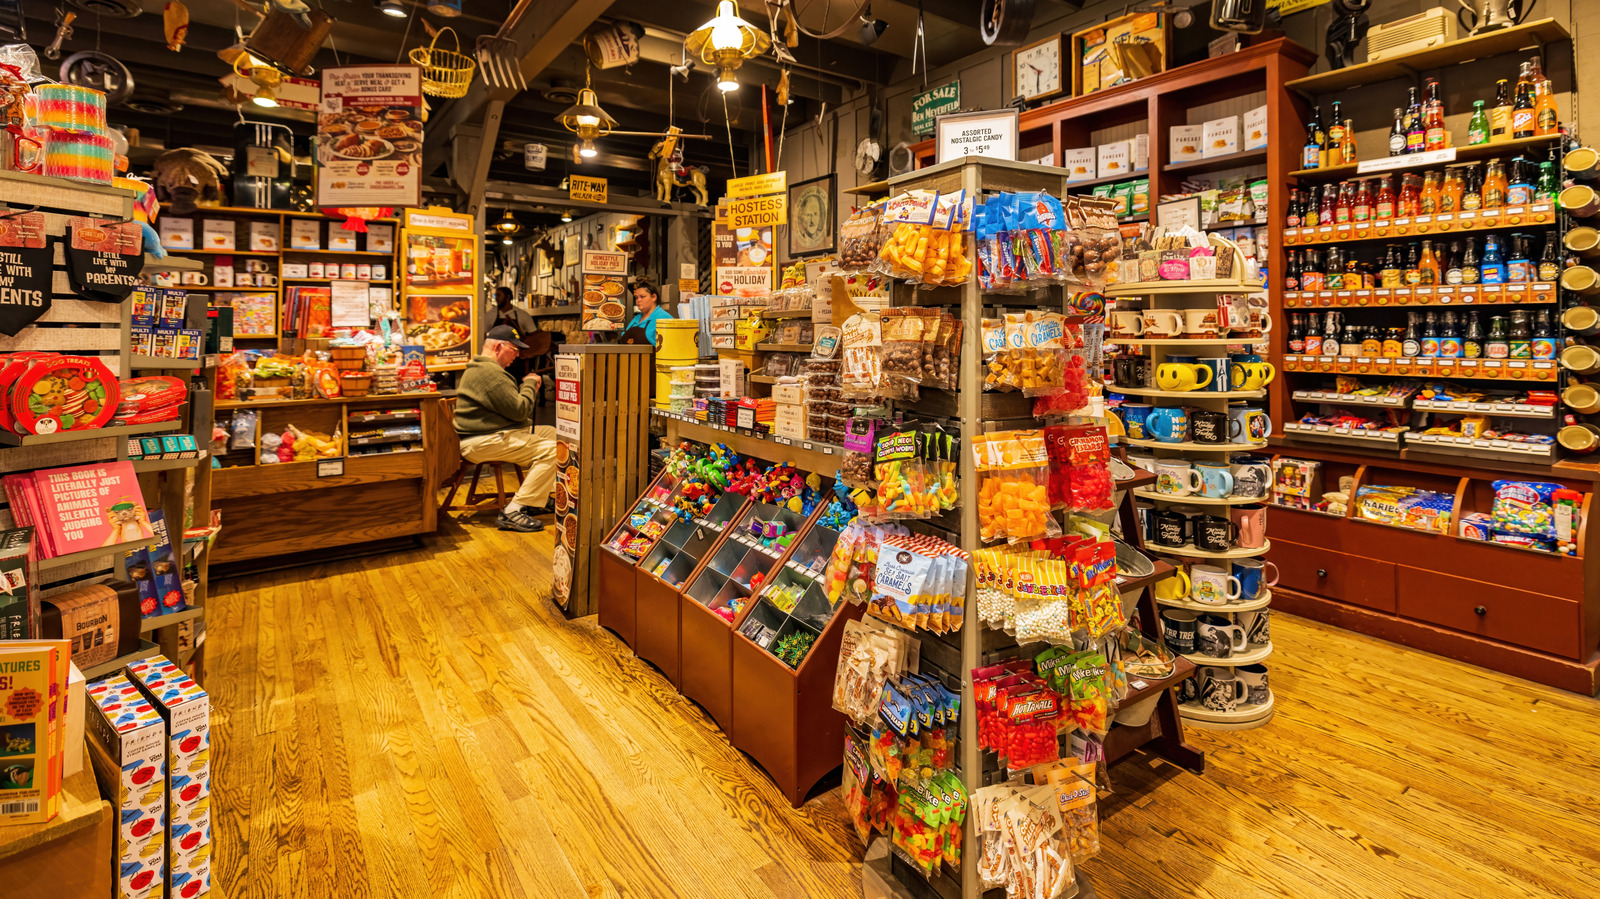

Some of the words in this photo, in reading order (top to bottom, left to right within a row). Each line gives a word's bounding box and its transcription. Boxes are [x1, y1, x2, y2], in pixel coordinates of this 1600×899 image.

[913, 93, 932, 111] FOR
[932, 87, 957, 100] SALE
[951, 135, 982, 144] NOSTALGIC
[983, 134, 1003, 142] CANDY
[961, 128, 992, 137] ASSORTED
[1207, 128, 1233, 138] PANCAKE
[963, 147, 969, 155] 3
[1102, 152, 1125, 160] PANCAKE
[571, 179, 606, 193] RITE-WAY
[730, 198, 783, 215] HOSTESS
[734, 211, 779, 227] STATION
[93, 257, 108, 266] LIVE
[110, 259, 127, 268] WITH
[6, 265, 32, 278] WITH
[105, 266, 117, 274] MY
[86, 272, 136, 286] PARENTS
[733, 275, 766, 285] HOLIDAY
[1035, 319, 1060, 333] Vanilla
[1030, 328, 1063, 347] CARAMELS
[66, 358, 91, 367] TREATS
[1069, 435, 1105, 446] CINNAMON
[1074, 442, 1104, 453] BEARS
[47, 473, 70, 483] THIS
[71, 469, 97, 481] BOOK
[96, 468, 107, 478] IS
[50, 478, 97, 493] LITERALLY
[99, 476, 121, 487] JUST
[53, 488, 98, 503] PICTURES
[98, 486, 110, 496] OF
[56, 497, 99, 512] ANIMALS
[58, 507, 100, 522] SILENTLY
[62, 517, 103, 532] JUDGING
[63, 530, 84, 541] YOU
[884, 567, 896, 578] SEA
[895, 571, 911, 582] SALT
[876, 573, 912, 595] CARAMELS
[76, 614, 108, 631] BOURBON
[1166, 627, 1178, 638] TAR
[1179, 631, 1195, 639] TREK
[173, 702, 208, 719] FRIENDS
[125, 730, 163, 749] FRIENDS
